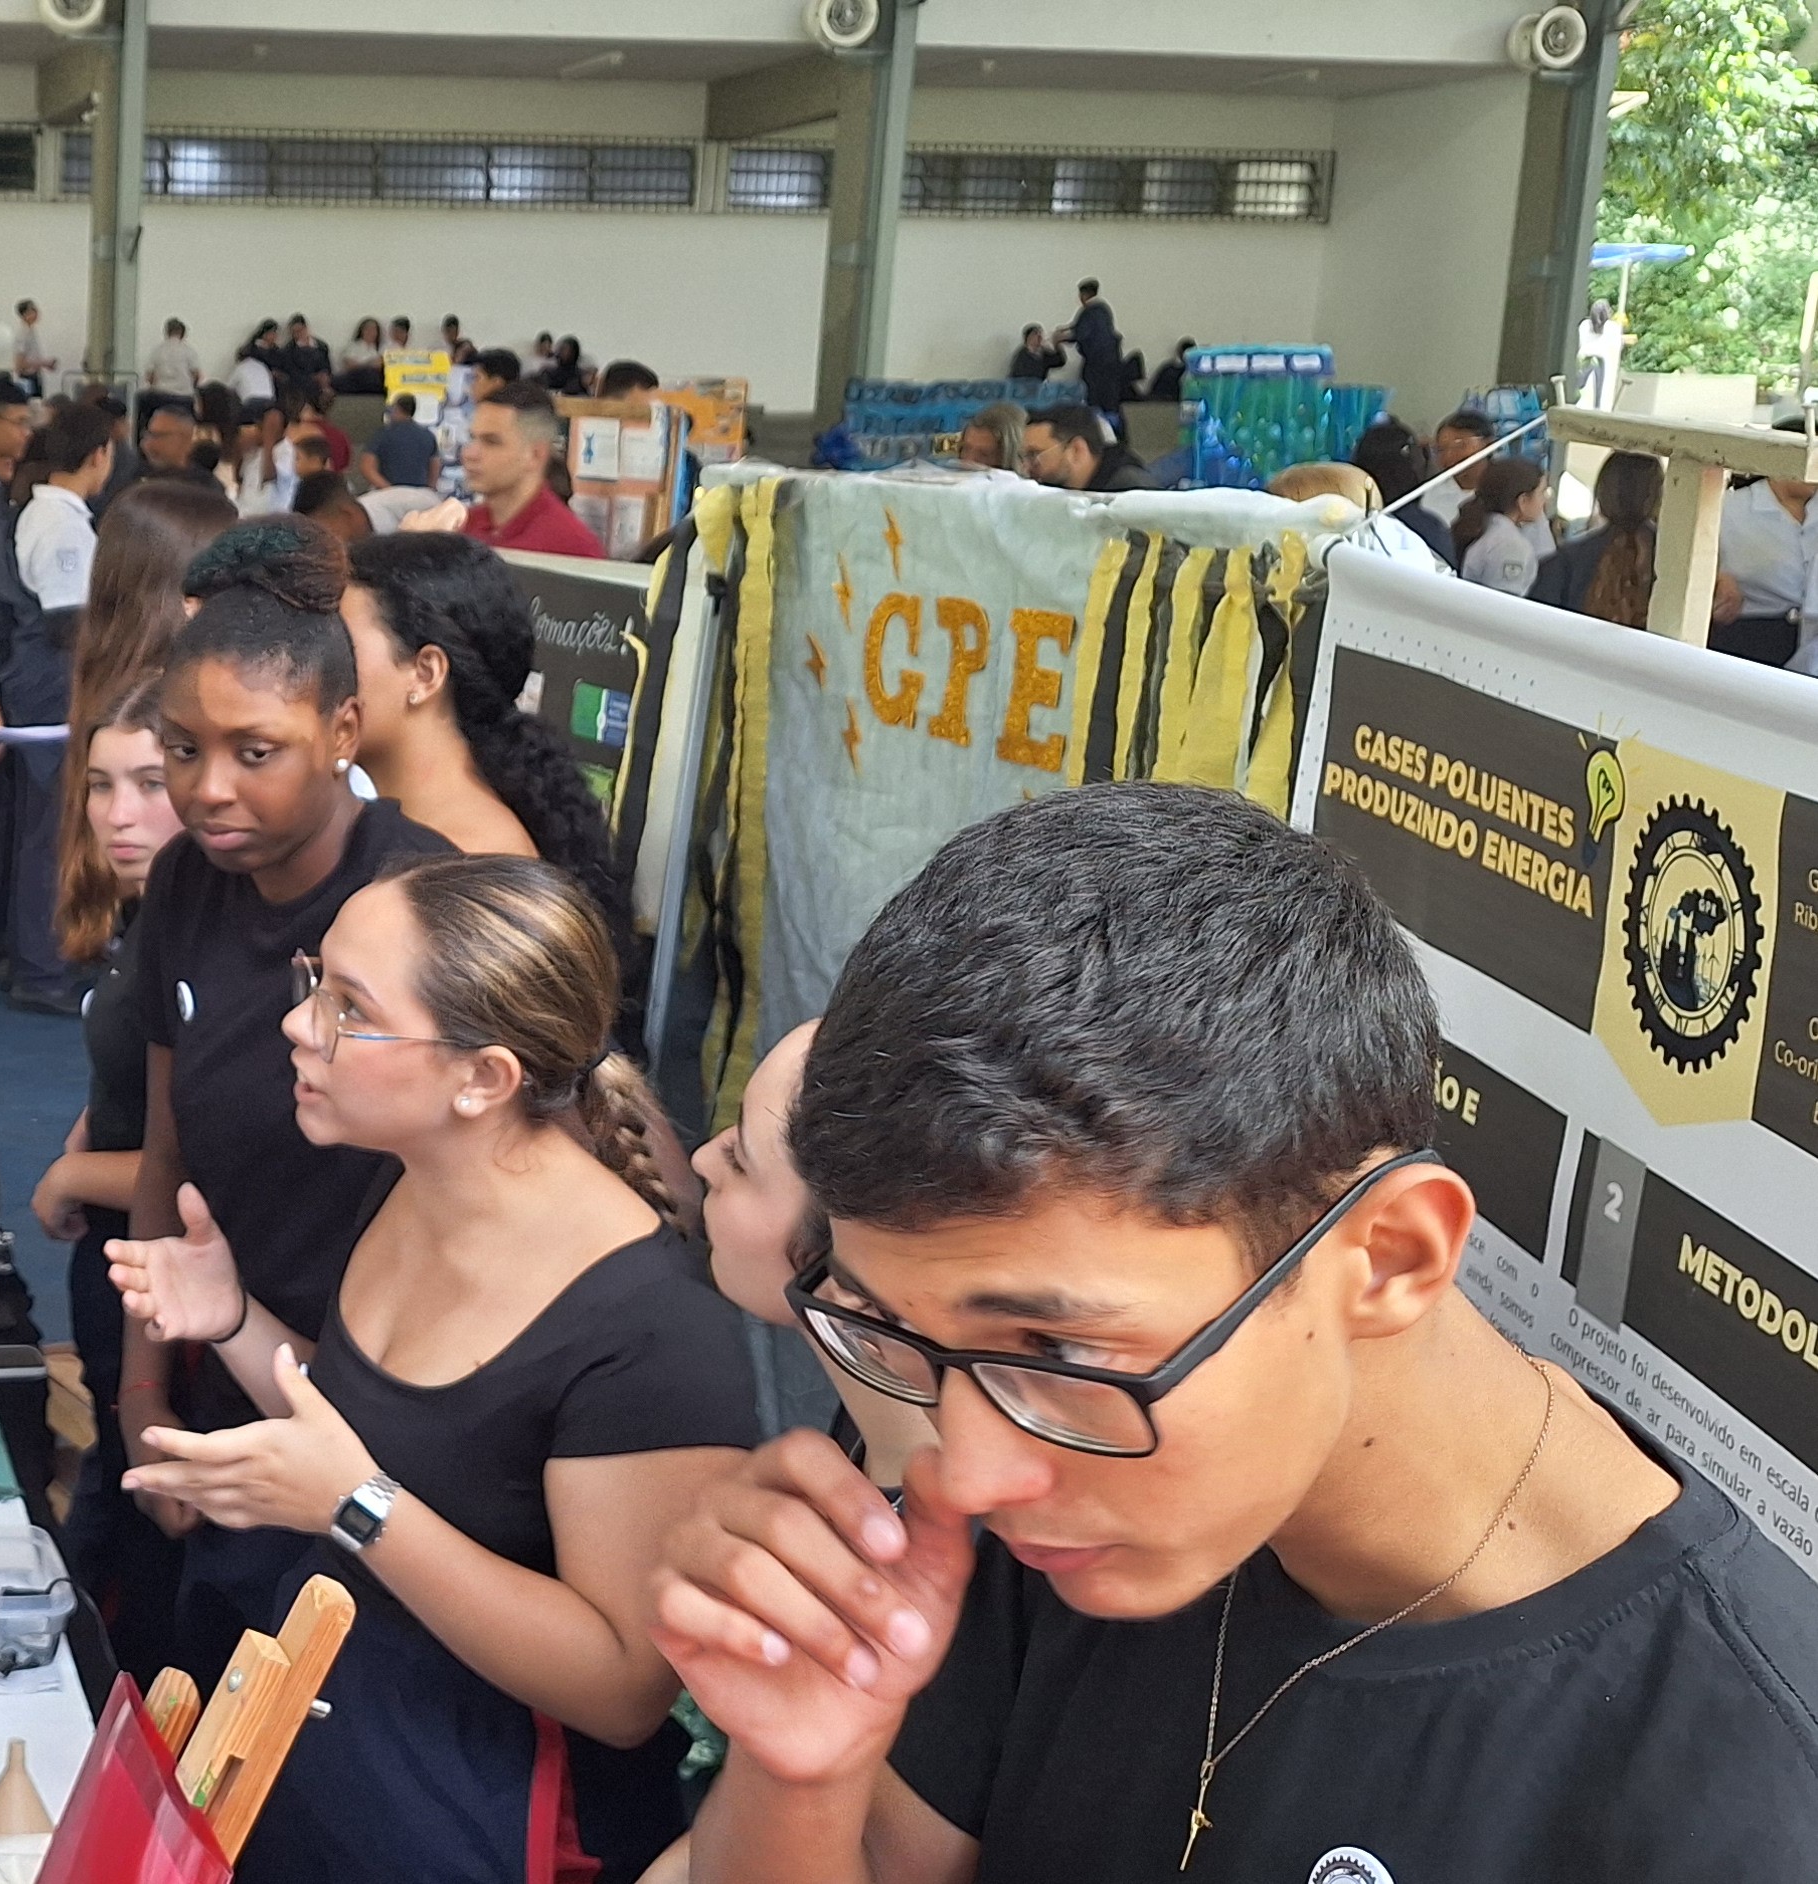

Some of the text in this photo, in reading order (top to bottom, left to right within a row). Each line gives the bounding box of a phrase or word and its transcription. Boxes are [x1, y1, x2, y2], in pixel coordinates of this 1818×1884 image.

[864, 592, 1076, 774] GPE
[1323, 761, 1594, 919] PRODUZINDO ENERGIA
[1355, 723, 1576, 849] GASES POLUENTES
[1462, 1087, 1481, 1126] E
[1603, 1181, 1624, 1223] 2
[1496, 1255, 1518, 1281] com
[1501, 1292, 1535, 1330] somos
[1550, 1332, 1621, 1394] compressor
[1626, 1388, 1642, 1412] de
[1647, 1408, 1662, 1426] ar
[1666, 1422, 1696, 1457] para
[1701, 1451, 1754, 1502] simular
[1757, 1499, 1766, 1516] a
[1773, 1510, 1813, 1556] vazão
[1569, 1308, 1810, 1513] O projeto foi desenvolvido em escala
